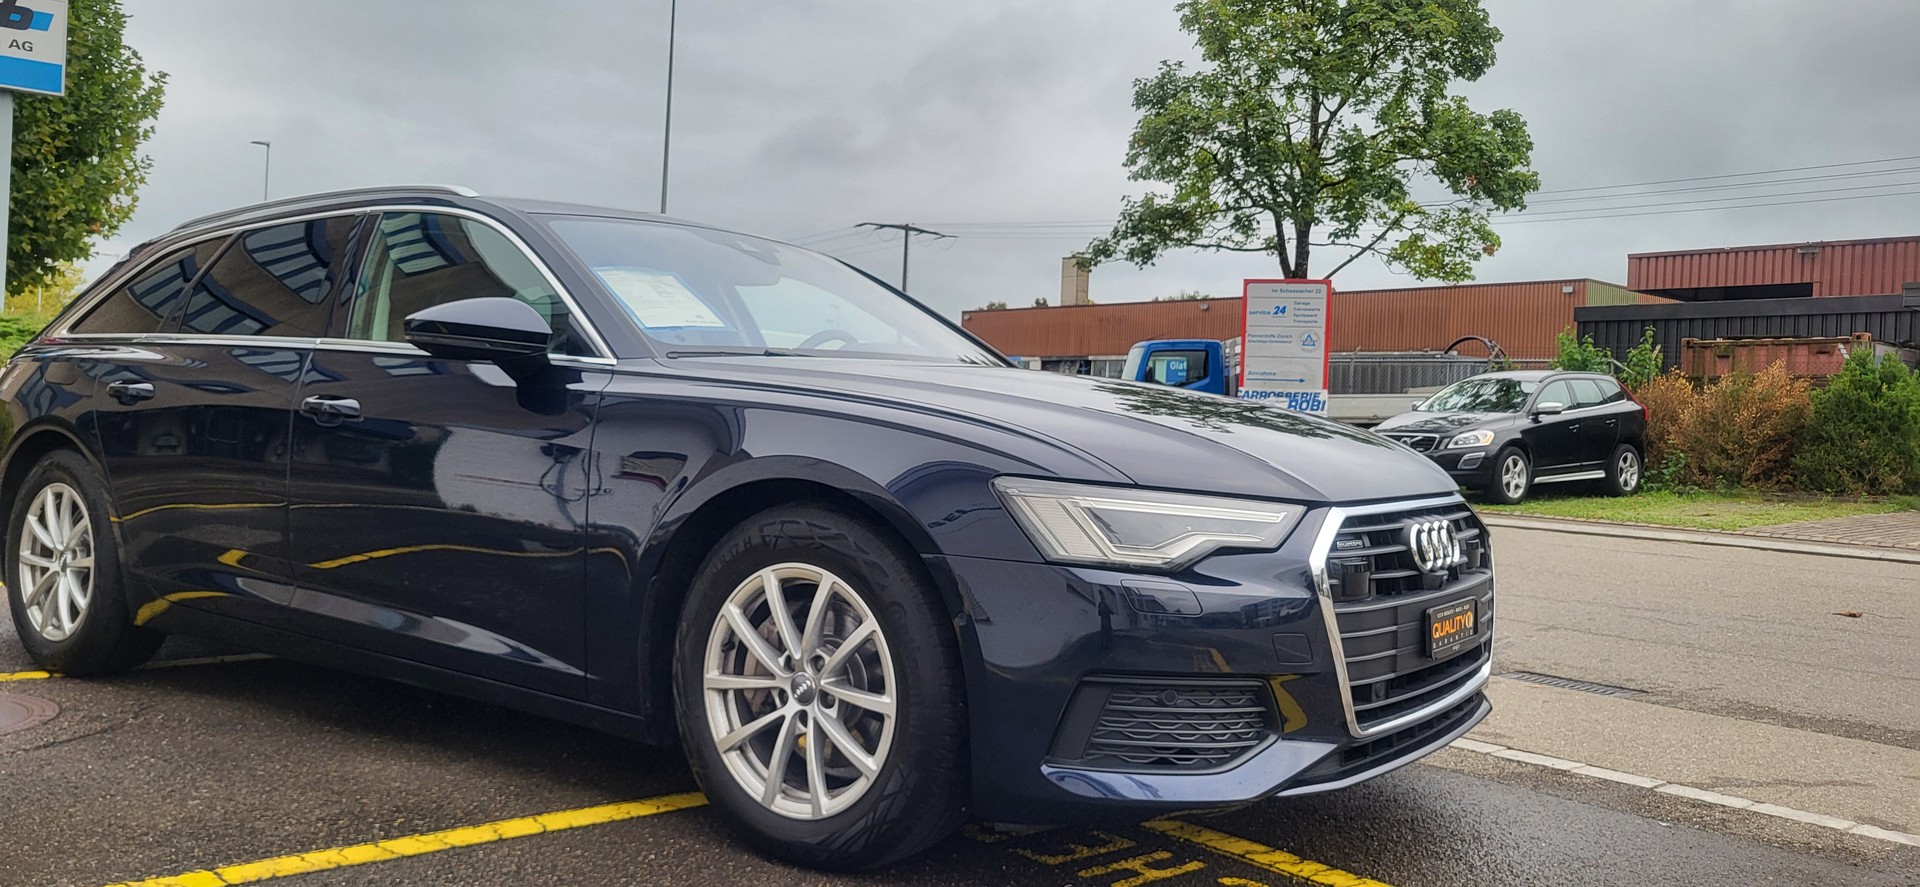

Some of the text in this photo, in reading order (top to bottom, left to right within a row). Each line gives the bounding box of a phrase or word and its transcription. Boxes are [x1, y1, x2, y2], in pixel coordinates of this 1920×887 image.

[8, 39, 34, 52] AG
[1272, 305, 1288, 316] 24
[1287, 399, 1326, 411] ROBI
